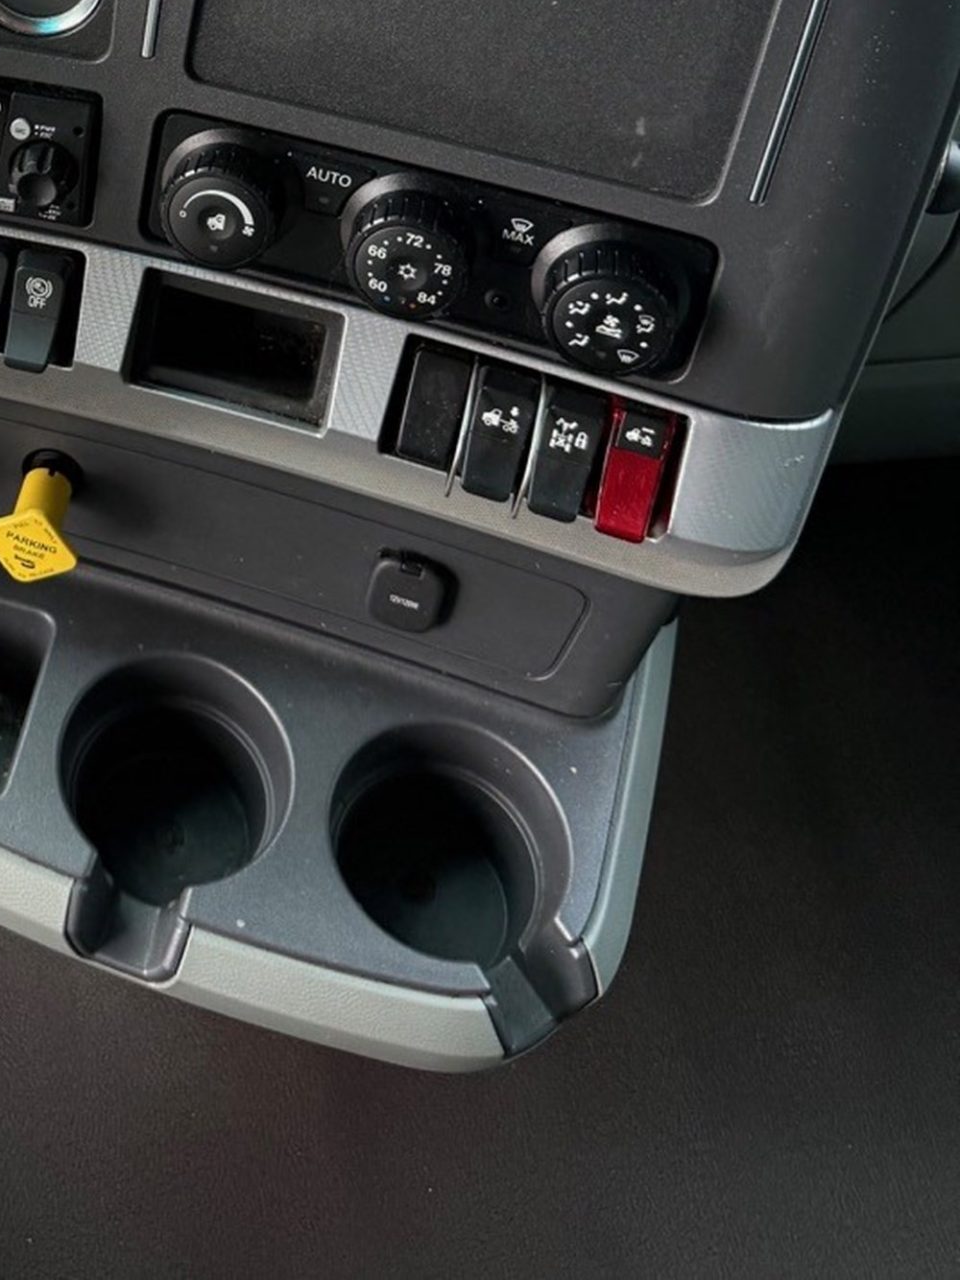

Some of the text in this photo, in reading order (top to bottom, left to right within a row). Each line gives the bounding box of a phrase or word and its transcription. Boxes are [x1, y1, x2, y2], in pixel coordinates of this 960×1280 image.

[305, 165, 352, 188] AUTO
[404, 232, 425, 249] 72
[501, 228, 536, 246] MAX
[367, 243, 388, 260] 66
[433, 262, 454, 277] 78
[368, 277, 389, 293] 60
[27, 295, 47, 309] OFF
[416, 291, 438, 306] 84
[6, 530, 58, 554] PARKING
[13, 544, 46, 561] BRAKE
